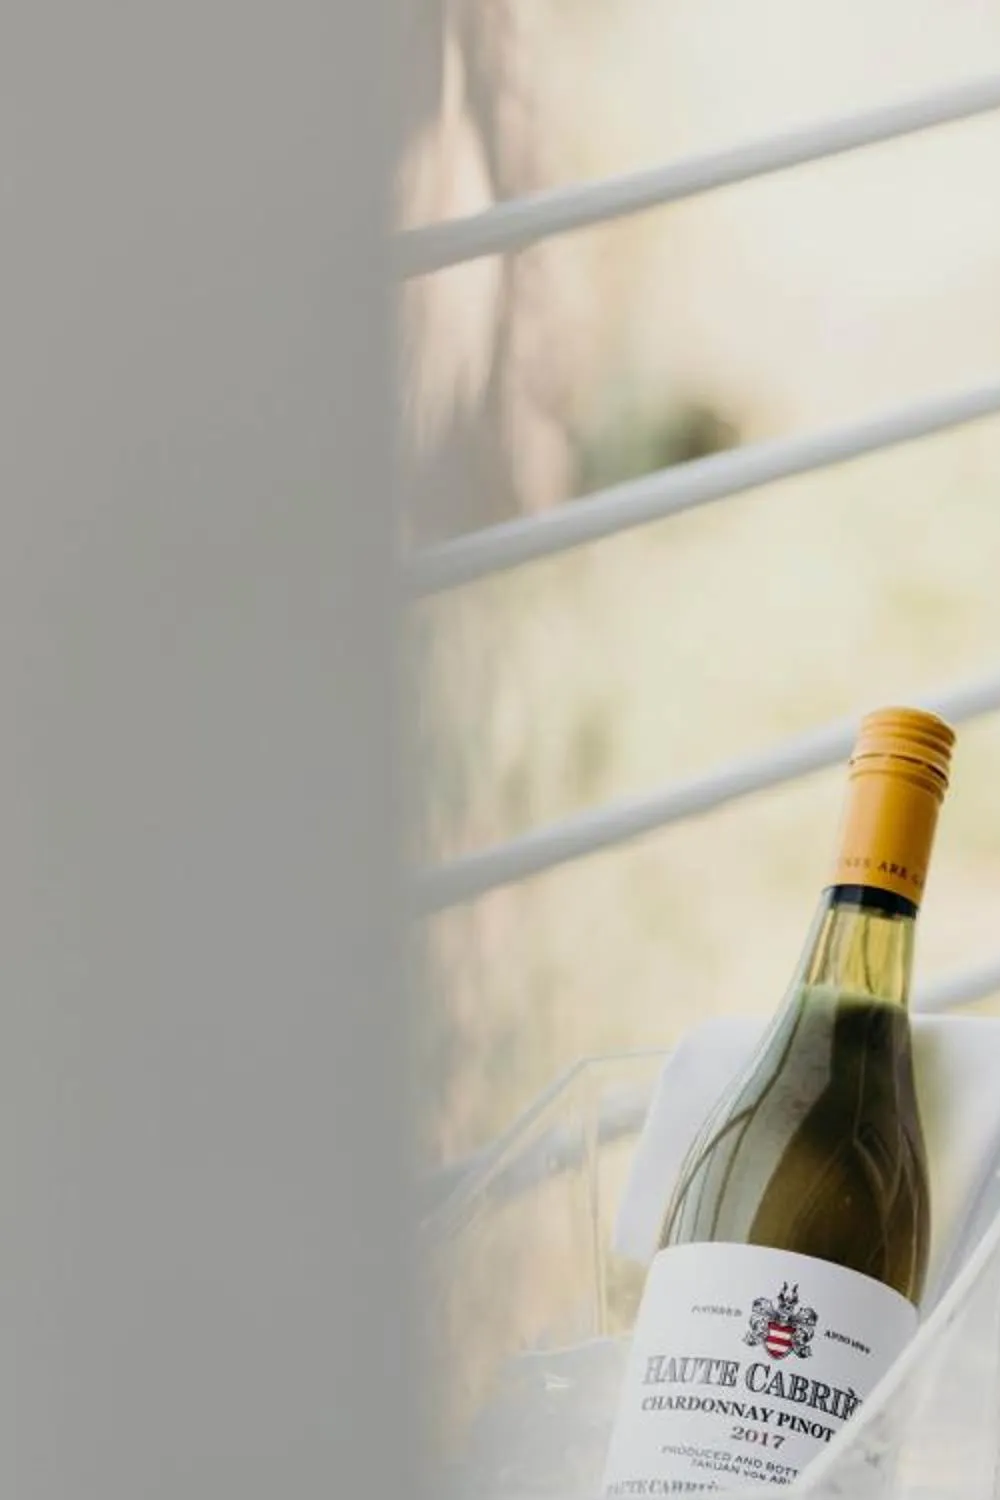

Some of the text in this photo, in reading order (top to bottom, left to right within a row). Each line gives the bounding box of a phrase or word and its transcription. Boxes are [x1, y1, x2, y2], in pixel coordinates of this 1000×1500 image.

[643, 1355, 739, 1387] HAUTE
[642, 1396, 836, 1443] CHARDONNAY PINOT
[730, 1426, 785, 1449] 2017
[661, 1445, 732, 1462] PRODUCED
[735, 1455, 763, 1469] AND
